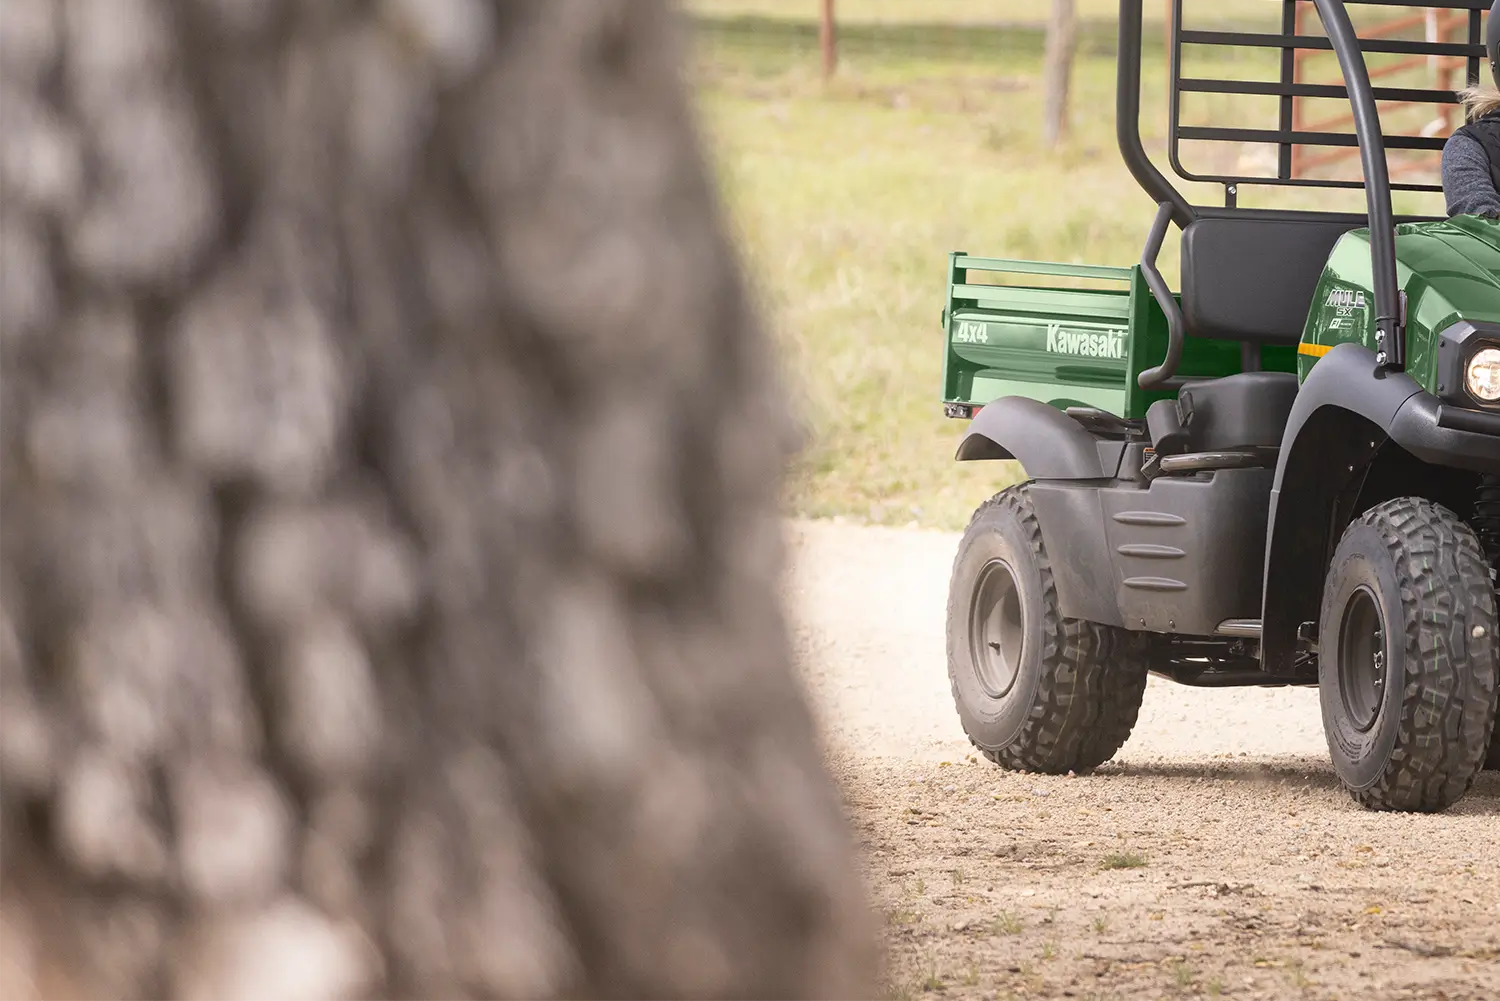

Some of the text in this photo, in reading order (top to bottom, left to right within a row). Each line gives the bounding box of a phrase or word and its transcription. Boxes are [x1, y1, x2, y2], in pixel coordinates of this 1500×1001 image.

[1326, 290, 1366, 308] MULE
[1336, 307, 1353, 317] SX
[958, 322, 1123, 358] 4x4 Kawasaki
